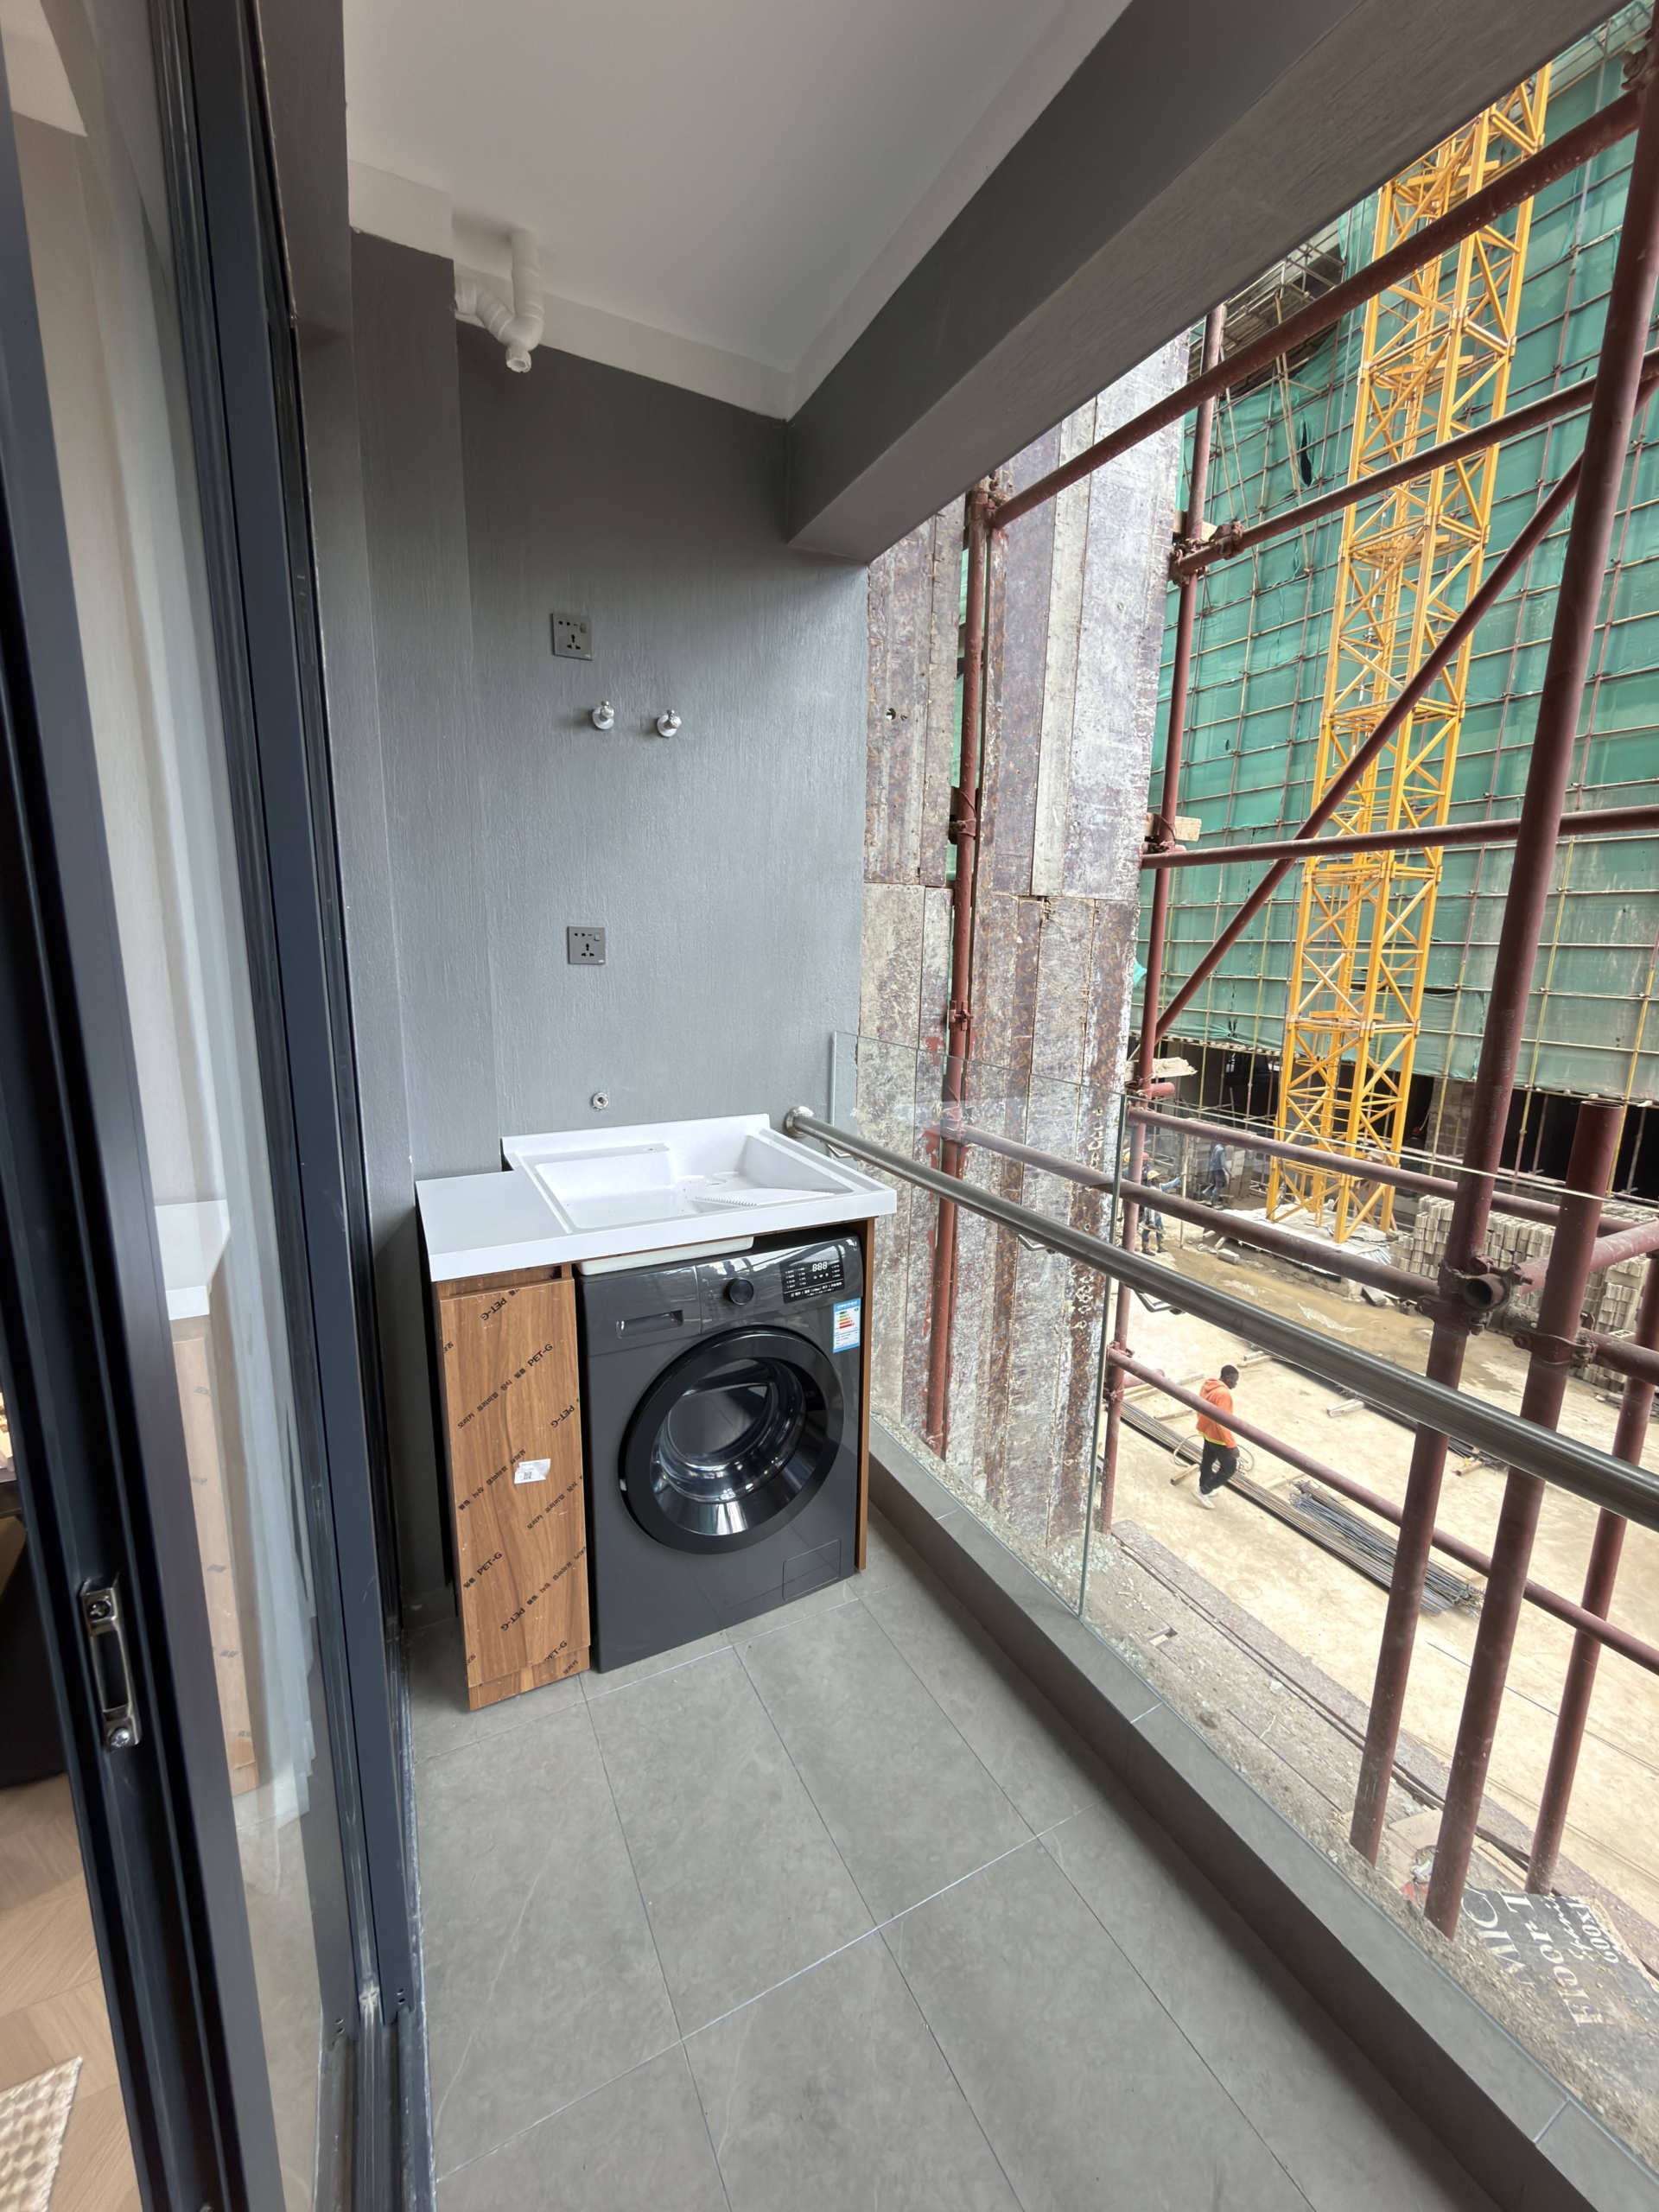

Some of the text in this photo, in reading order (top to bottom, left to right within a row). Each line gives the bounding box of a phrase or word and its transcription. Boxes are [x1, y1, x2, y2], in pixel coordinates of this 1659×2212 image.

[812, 1262, 828, 1272] 888
[480, 1297, 508, 1321] PET-G
[457, 1343, 554, 1429] 모리카 프리미엄 장식 필름 PET-G
[550, 1404, 575, 1428] PET-G
[486, 1465, 508, 1486] 프리미엄
[526, 1514, 543, 1530] 모리카
[544, 1493, 566, 1514] 프리미엄
[476, 1551, 503, 1576] PET-G
[551, 1560, 573, 1581] 프리미엄
[500, 1606, 526, 1632] PET-G
[1525, 1921, 1604, 2027] Floor
